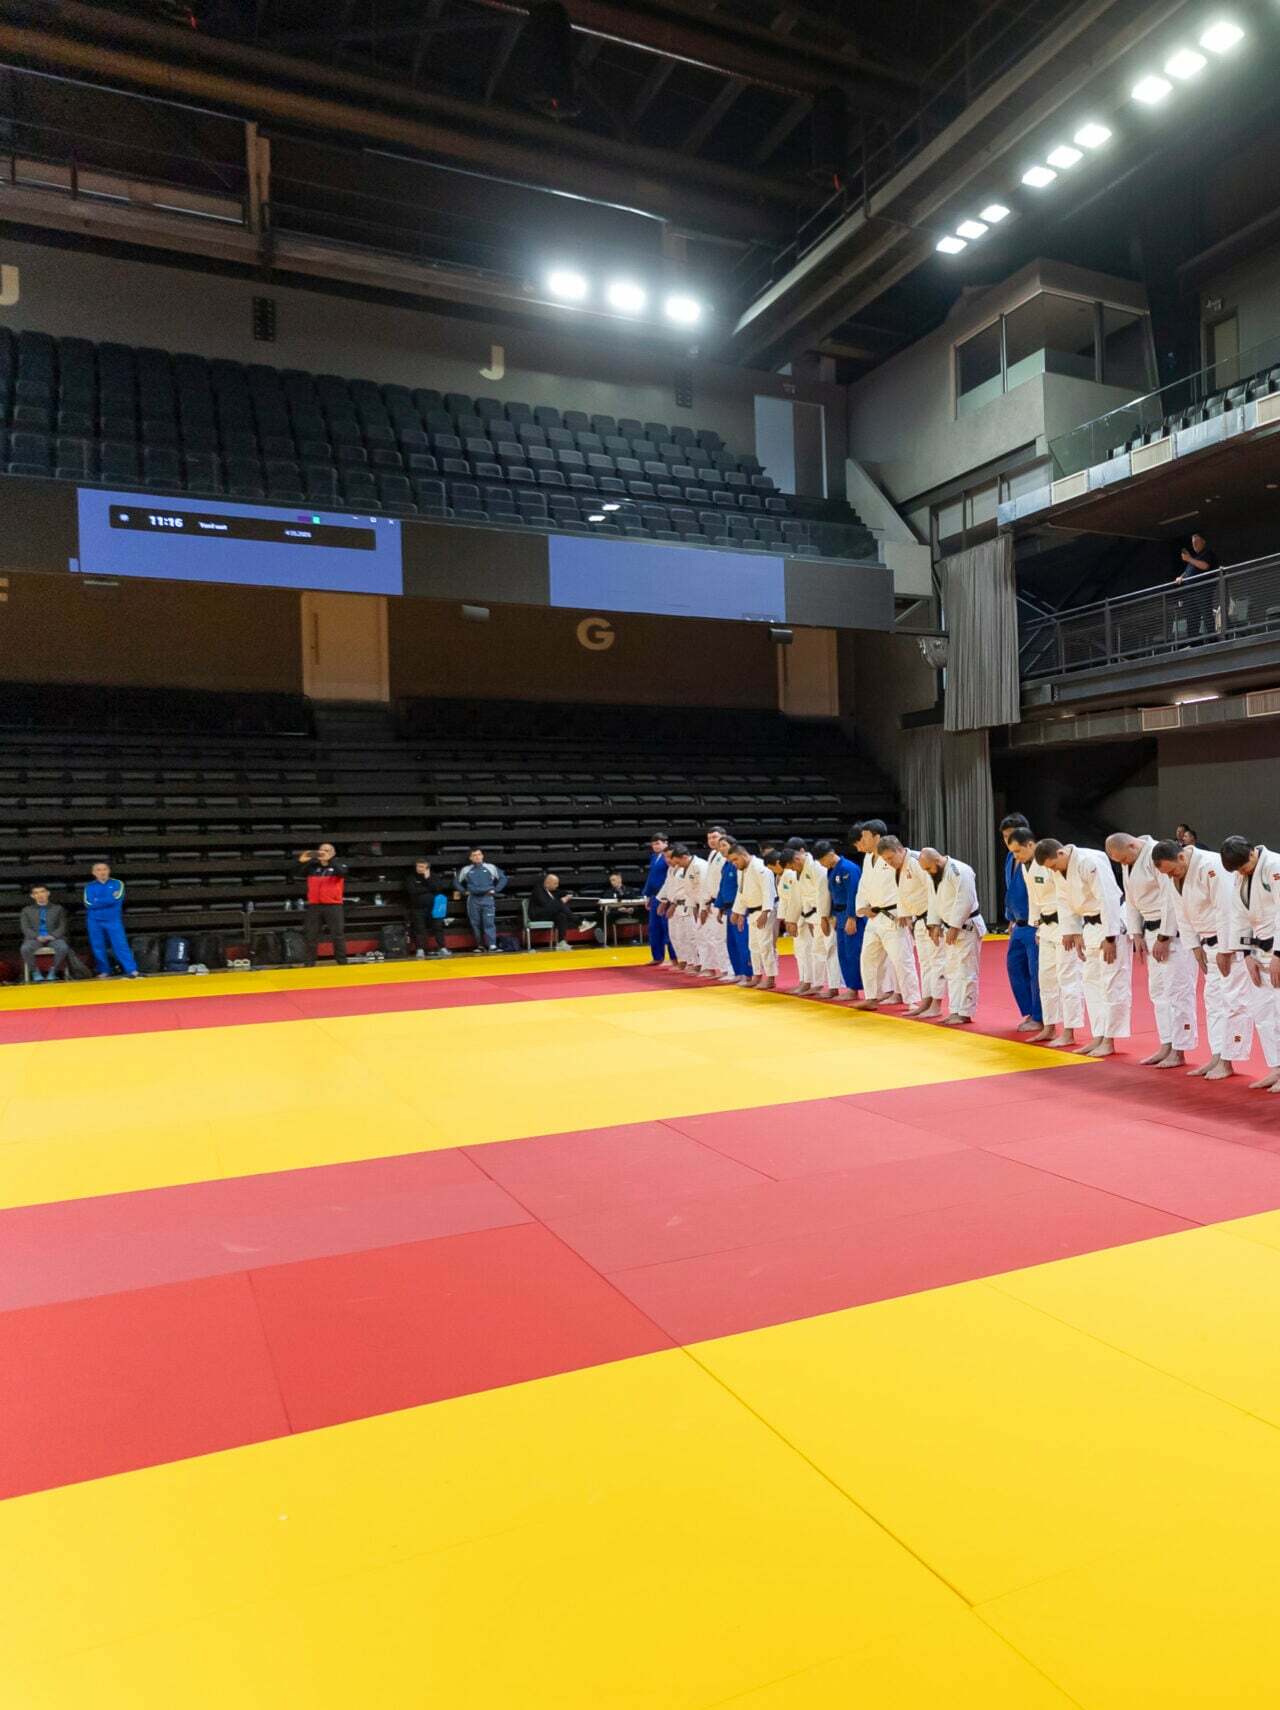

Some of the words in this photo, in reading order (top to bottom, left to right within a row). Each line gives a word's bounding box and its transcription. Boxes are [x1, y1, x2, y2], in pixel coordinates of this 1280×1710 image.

[480, 344, 505, 380] J
[148, 515, 184, 528] 11:16
[577, 617, 615, 650] G
